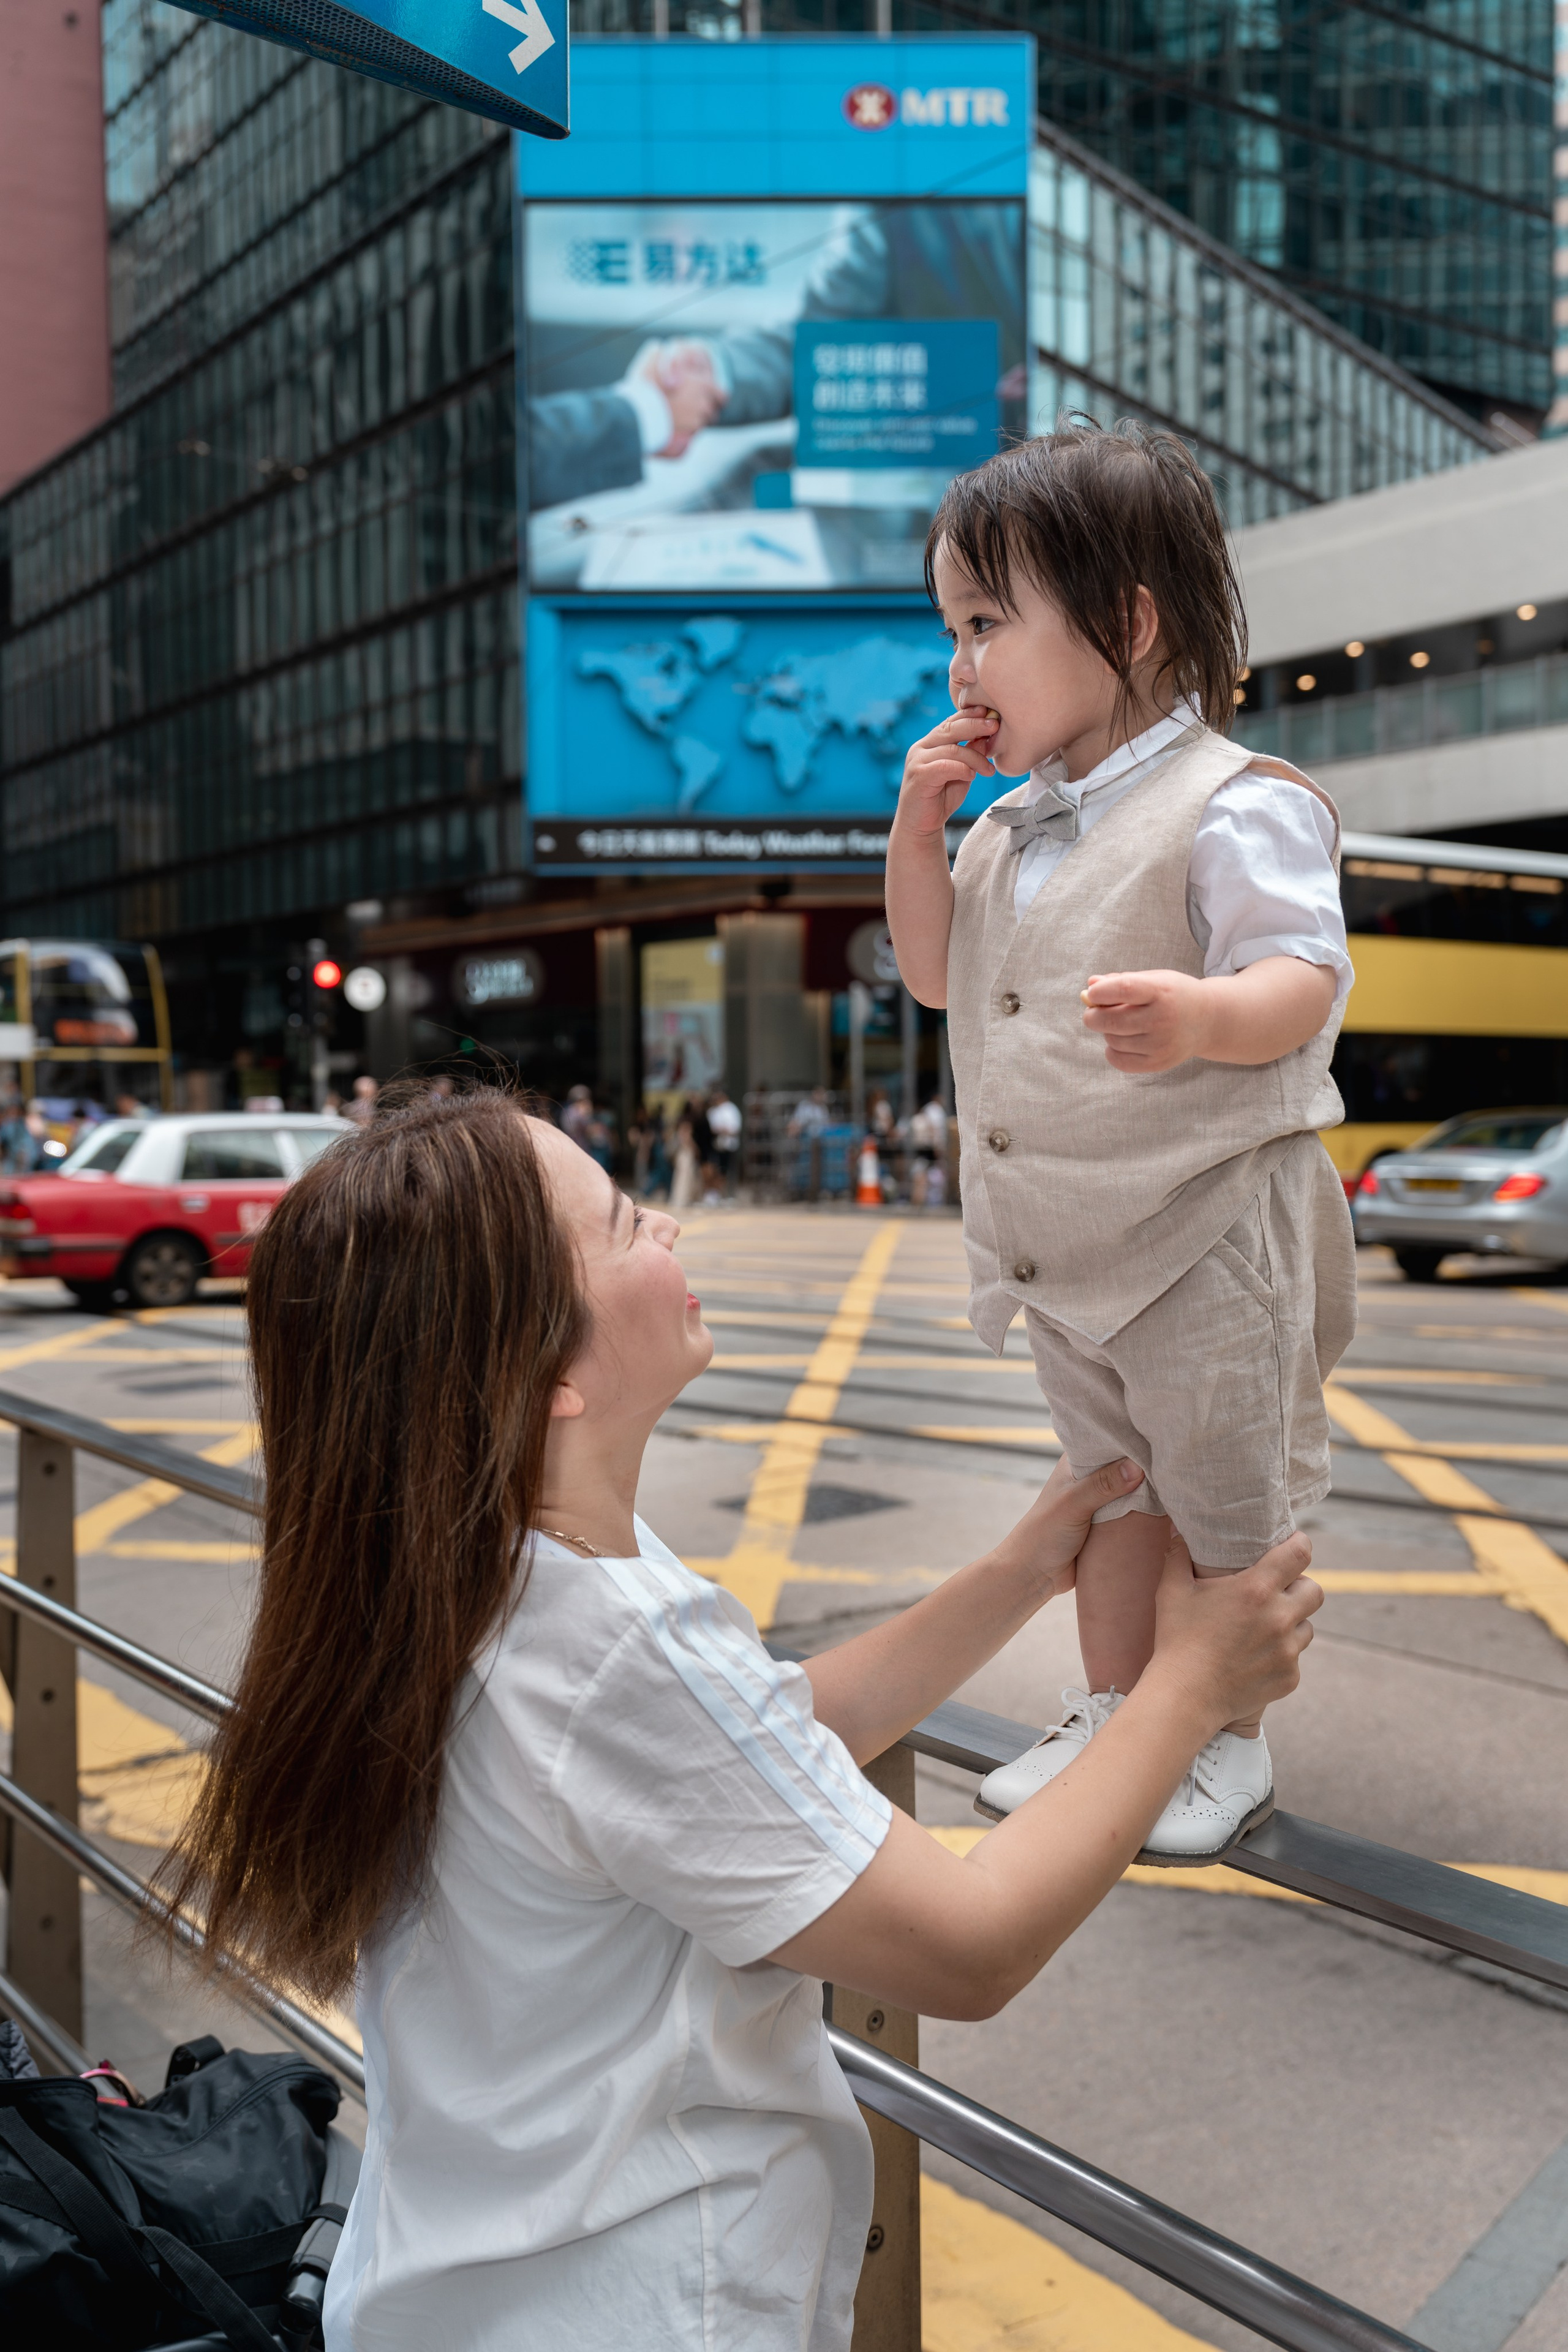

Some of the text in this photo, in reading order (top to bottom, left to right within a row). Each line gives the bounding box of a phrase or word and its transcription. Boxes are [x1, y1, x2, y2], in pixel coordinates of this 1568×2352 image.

[900, 86, 1009, 127] MTR
[704, 829, 762, 860] Today
[762, 829, 847, 855] Weather
